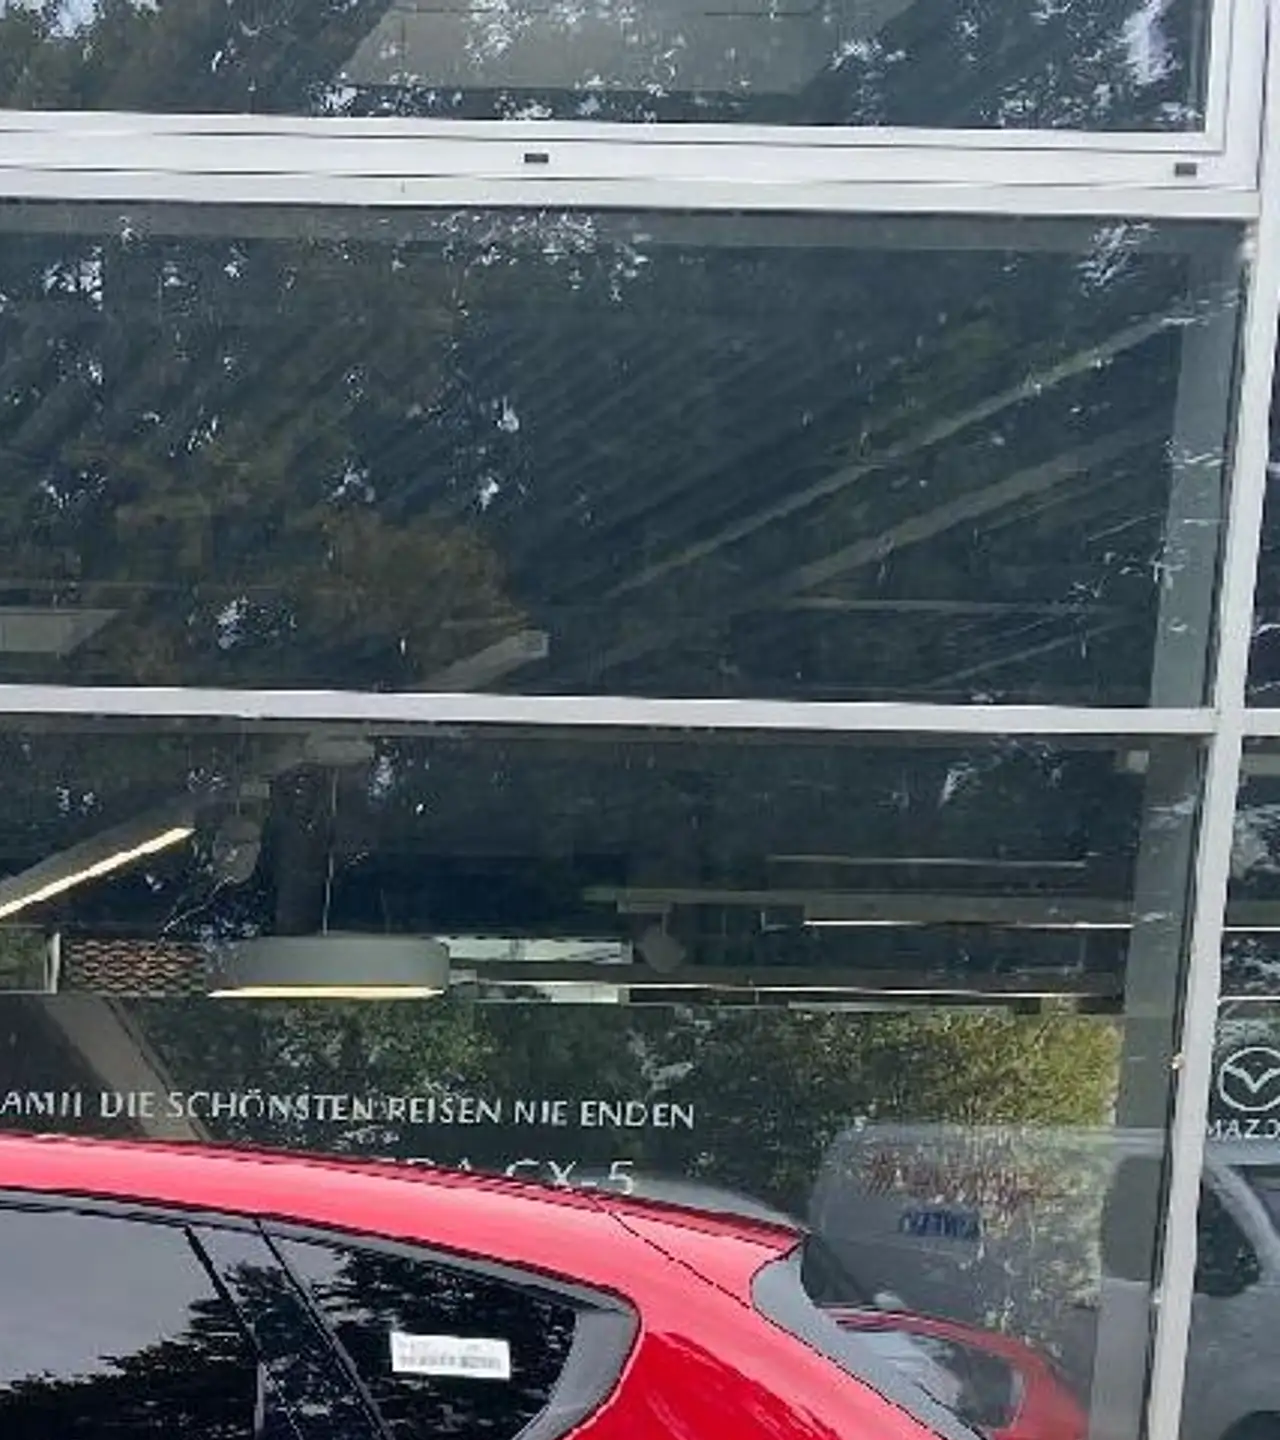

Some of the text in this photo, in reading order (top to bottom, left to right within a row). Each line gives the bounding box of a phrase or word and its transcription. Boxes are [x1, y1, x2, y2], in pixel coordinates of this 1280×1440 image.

[100, 1091, 156, 1118] DIE
[167, 1088, 374, 1122] SCHÖNSTEN
[388, 1097, 501, 1124] REISEN
[514, 1100, 568, 1126] NIE
[580, 1100, 695, 1130] ENDEN
